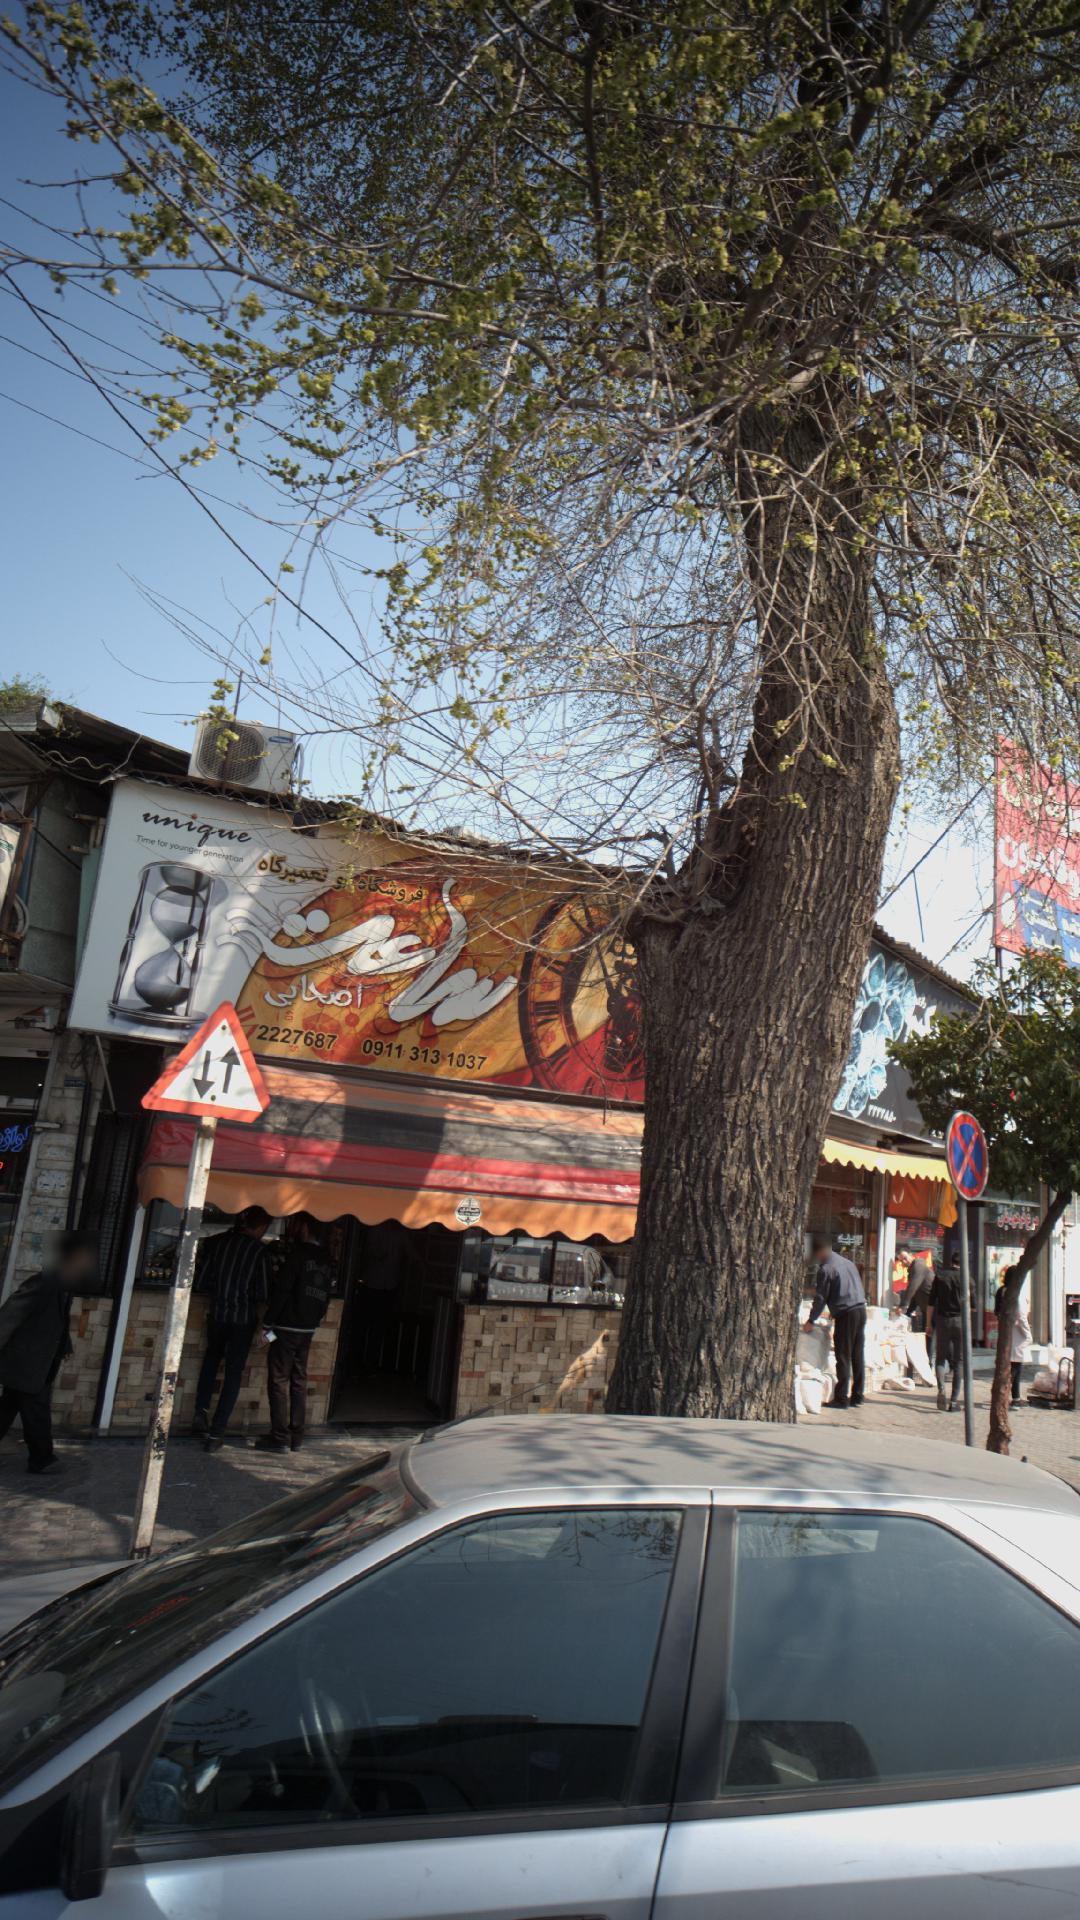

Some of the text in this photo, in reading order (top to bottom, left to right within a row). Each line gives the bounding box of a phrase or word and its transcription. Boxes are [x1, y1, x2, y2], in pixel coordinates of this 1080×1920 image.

[142, 812, 252, 847] unique
[136, 834, 244, 863] Time for younger generation
[256, 854, 329, 883] تعمیرگاه
[358, 874, 425, 903] فروشگاه
[228, 877, 518, 1026] ساعت
[256, 1025, 338, 1051] 2227687
[362, 1039, 488, 1071] 0911 313 1037
